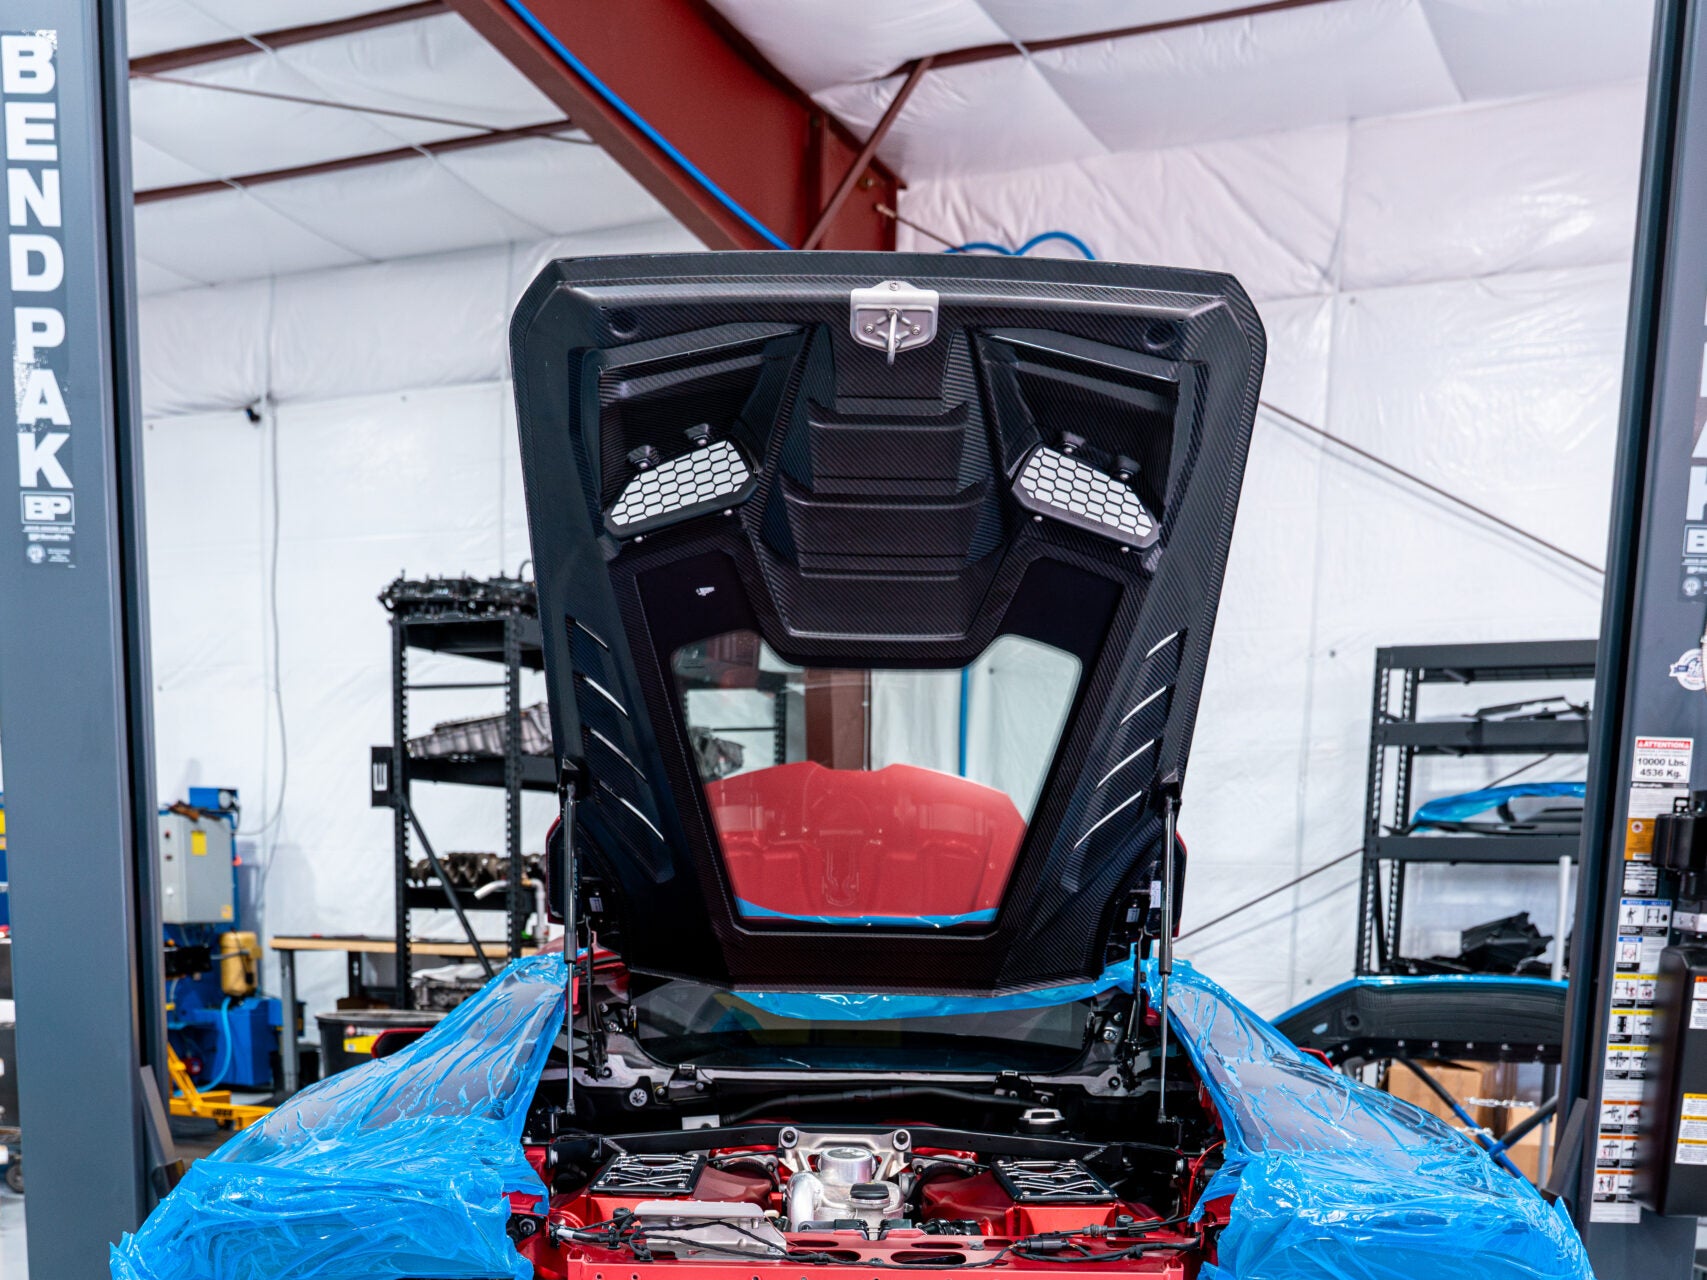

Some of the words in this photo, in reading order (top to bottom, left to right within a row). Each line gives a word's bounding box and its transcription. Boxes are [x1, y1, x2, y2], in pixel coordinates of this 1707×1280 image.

[1, 32, 74, 490] BENDPAK
[24, 495, 71, 521] BP
[1643, 741, 1684, 749] ATTENTION
[1638, 757, 1665, 766] 10000
